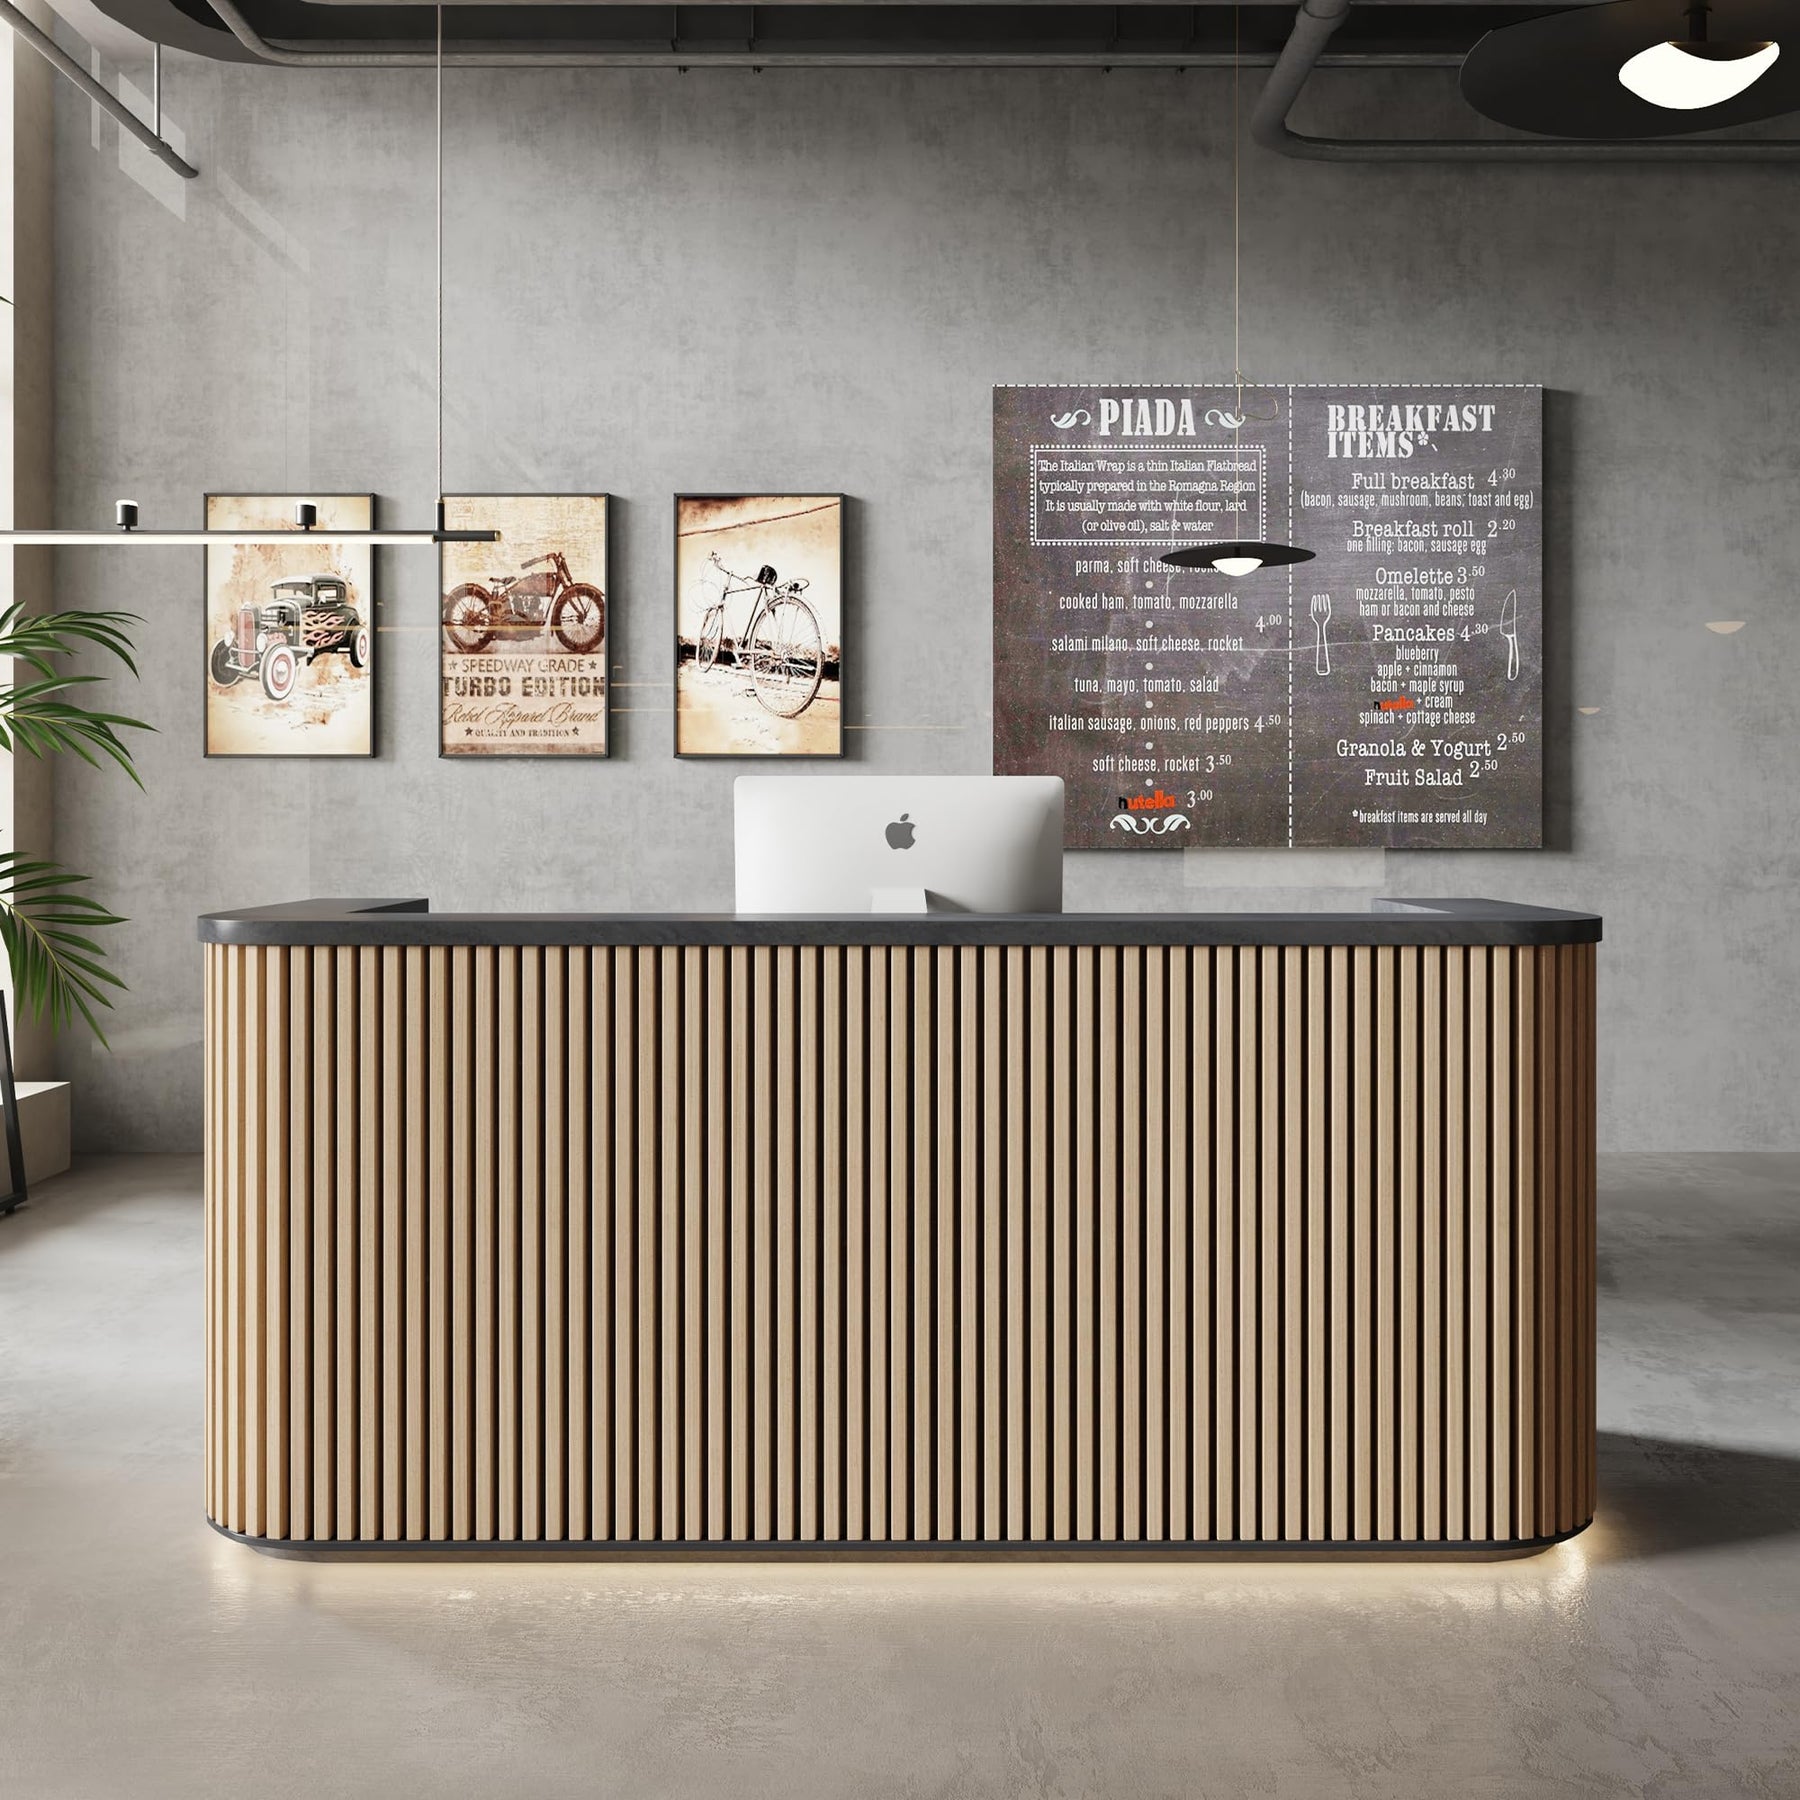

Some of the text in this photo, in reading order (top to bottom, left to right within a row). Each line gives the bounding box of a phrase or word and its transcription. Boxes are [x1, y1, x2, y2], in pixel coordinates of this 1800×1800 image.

[1100, 398, 1196, 436] PIADA
[1328, 405, 1496, 432] BREAKFAST
[1038, 460, 1256, 474] The Italian Wrap is a thin Italian Flatbread
[1039, 480, 1256, 493] typically prepared in the Romagna Region
[1352, 473, 1385, 490] Full
[1392, 473, 1474, 490] breakfast
[1046, 500, 1247, 513] It is usually made with white flour, lard
[1300, 491, 1533, 509] (bacon, sausage, mushroom, beans, toast and egg)
[1082, 520, 1213, 533] (or olive oil), salt & water
[1353, 520, 1438, 538] Breakfast
[1444, 520, 1473, 538] roll
[1347, 538, 1487, 555] one filling: bacon, sausage egg
[1076, 558, 1185, 576] parma, soft cheese,
[1376, 568, 1453, 585] Omelette
[1060, 593, 1238, 610] cooked ham, tomato, mozzarella
[1356, 586, 1474, 603] mozzarella, tomato, pesto
[1360, 601, 1474, 616] ham or bacon and cheese
[1373, 625, 1455, 642] Pancakes
[1052, 636, 1243, 651] salami milano, soft cheese, rocket
[1396, 645, 1439, 663] blueberry
[462, 658, 585, 673] SPEEDWAY GRADE
[1378, 661, 1402, 679] apple
[1414, 661, 1457, 676] cinnamon
[443, 676, 605, 697] TURBO EDITION
[1074, 678, 1219, 696] tuna, mayo, tomato, salad
[1371, 677, 1397, 692] bacon
[1410, 677, 1437, 695] maple
[1440, 680, 1464, 695] syrup
[1425, 696, 1453, 708] cream
[443, 702, 604, 729] Rebel Apparel Brand
[1050, 714, 1084, 731] italian
[1088, 718, 1135, 733] sausage,
[1140, 716, 1180, 731] onions,
[1184, 714, 1202, 731] red
[1206, 718, 1249, 733] peppers
[1360, 709, 1394, 727] spinach
[1407, 710, 1440, 727] cottage
[1444, 709, 1475, 724] cheese
[510, 728, 525, 737] AND
[1337, 740, 1406, 757] Granola
[1411, 740, 1425, 757] &
[1431, 740, 1491, 760] Yogurt
[1093, 756, 1115, 772] soft
[1119, 756, 1160, 772] cheese,
[1165, 756, 1200, 772] rocket
[1365, 768, 1409, 786] Fruit
[1415, 768, 1462, 786] Salad
[1118, 790, 1175, 810] nutella
[1398, 810, 1418, 823] items
[1421, 812, 1433, 823] are
[1436, 810, 1460, 823] served
[1463, 810, 1472, 823] all
[1474, 810, 1487, 825] day
